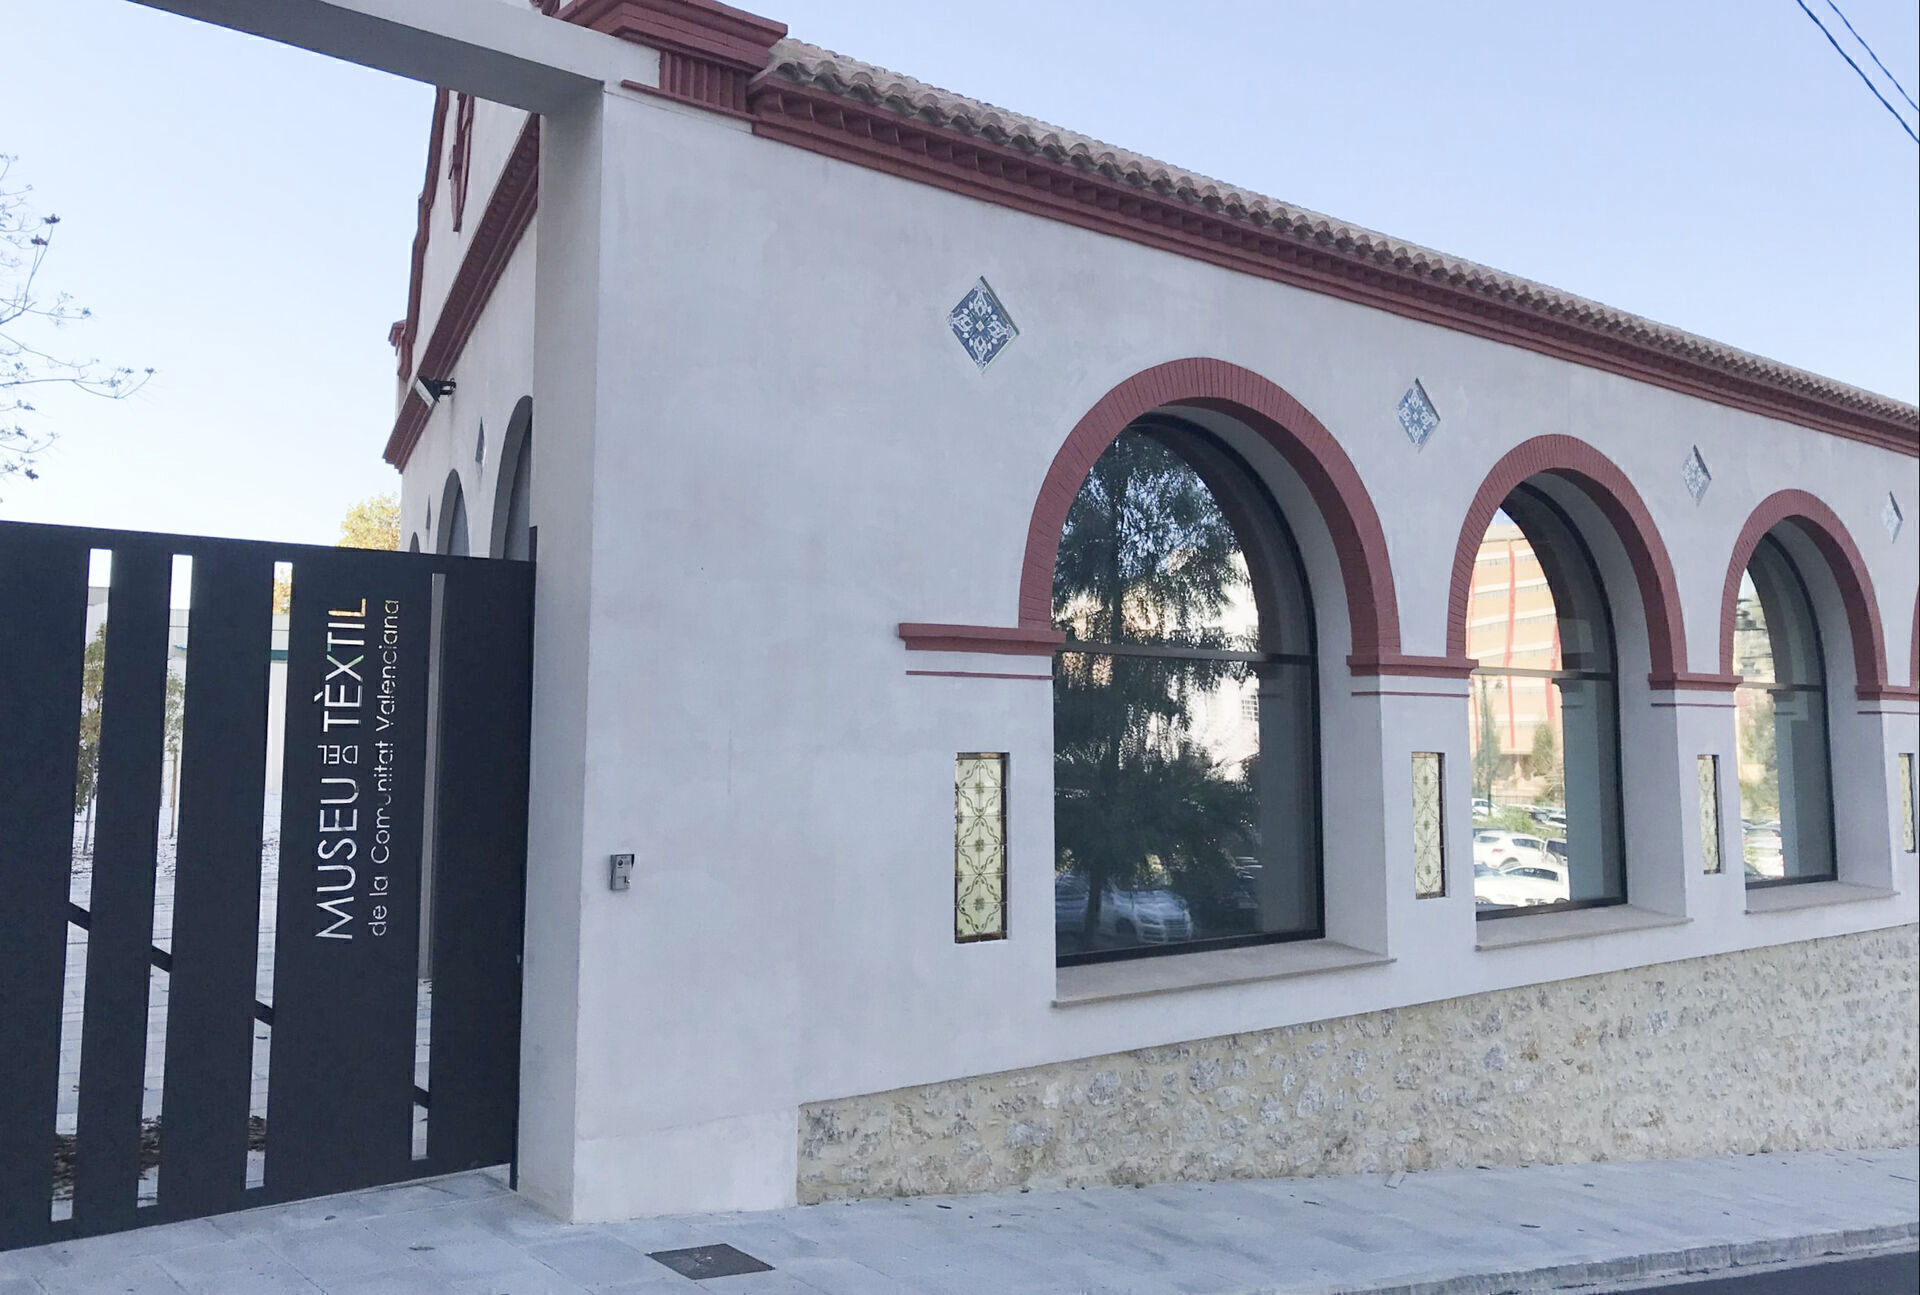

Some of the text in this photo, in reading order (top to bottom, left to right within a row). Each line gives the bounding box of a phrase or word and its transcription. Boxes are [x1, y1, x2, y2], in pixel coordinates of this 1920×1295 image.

[375, 599, 399, 732] Valenciana
[313, 598, 367, 940] MUSEU DEL TÈXTIL
[367, 904, 388, 937] de
[368, 876, 389, 896] la
